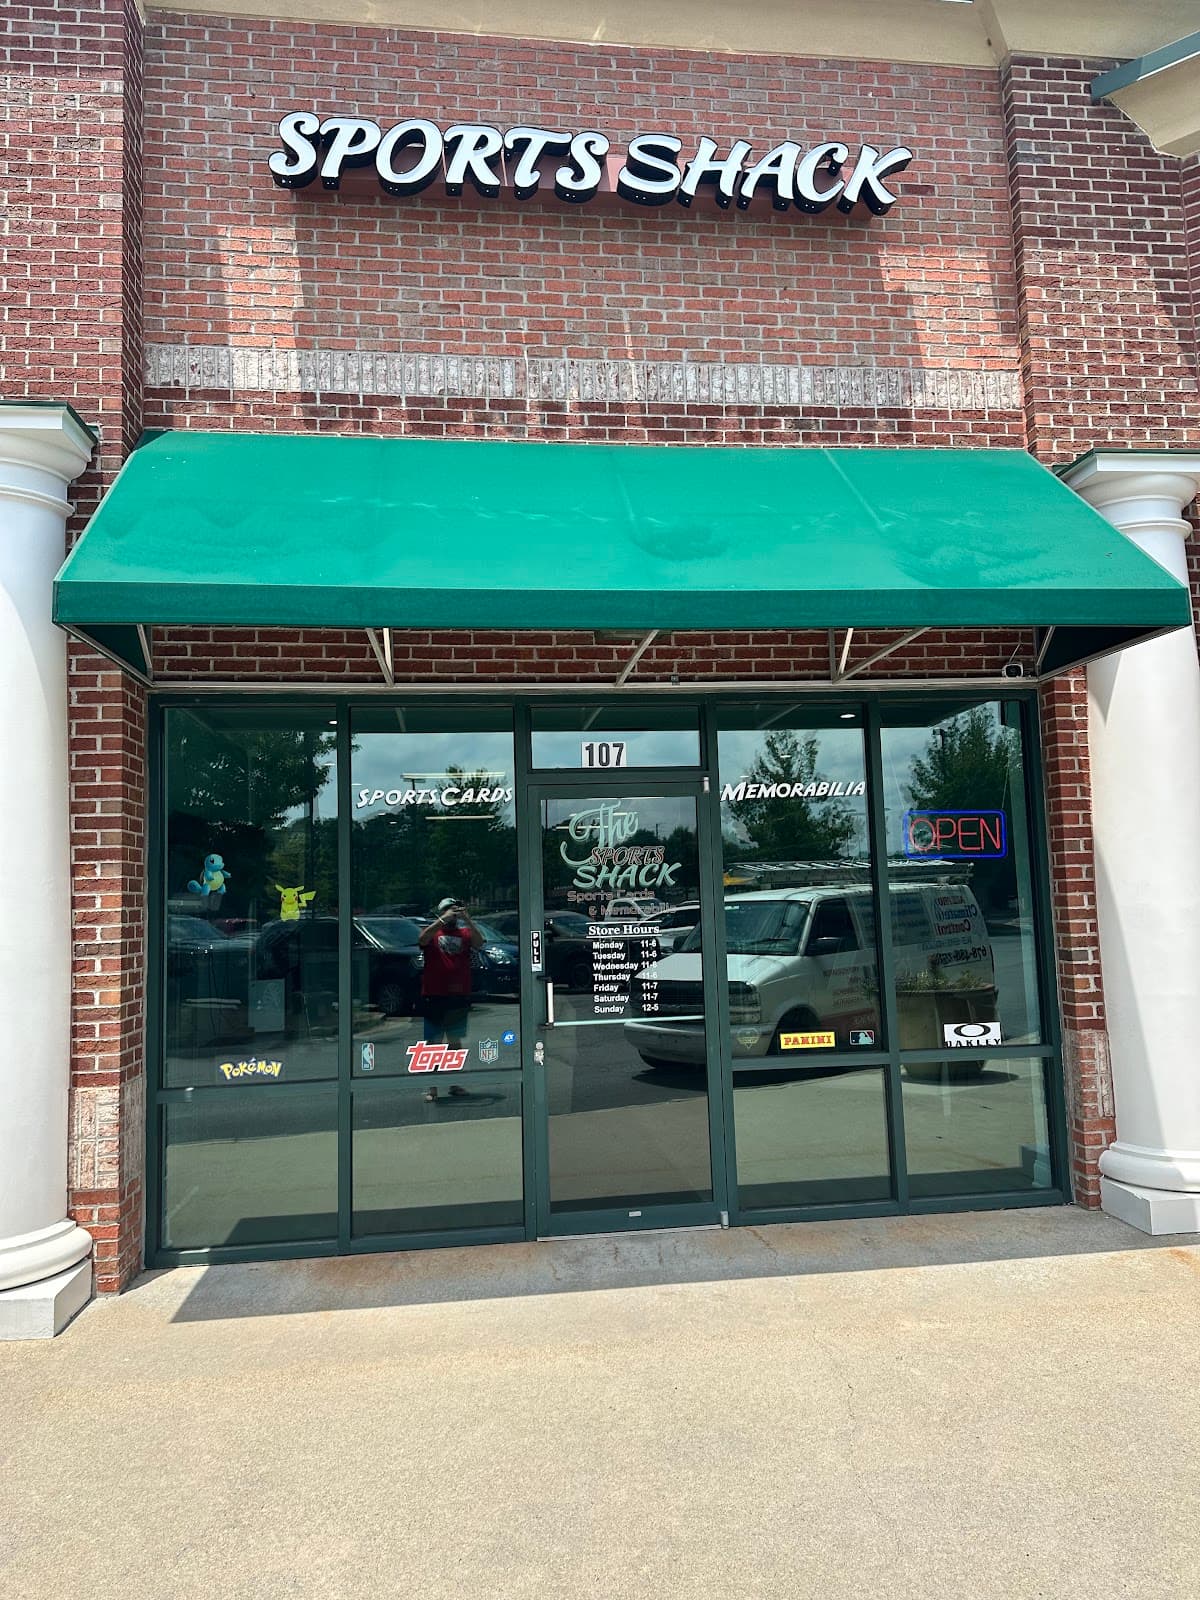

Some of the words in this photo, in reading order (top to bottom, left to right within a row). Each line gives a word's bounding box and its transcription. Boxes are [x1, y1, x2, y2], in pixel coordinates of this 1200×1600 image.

[267, 111, 611, 201] SPORTS
[617, 134, 913, 213] SHACK
[585, 742, 625, 767] 107
[720, 781, 866, 801] MEMORABILIA
[560, 800, 639, 867] The
[909, 817, 1000, 851] OPEN
[588, 846, 665, 866] SPORTS
[572, 862, 682, 889] SHACK
[567, 890, 614, 903] Sports
[616, 888, 655, 900] Cards
[588, 925, 620, 936] Store
[623, 924, 660, 935] Hours
[532, 932, 540, 963] PULL
[592, 941, 624, 951] Monday
[592, 951, 626, 961] Tuesday
[592, 962, 639, 972] Wednesday
[593, 972, 631, 982] Thursday
[593, 983, 619, 993] Friday
[641, 982, 658, 990] 11-7
[593, 994, 630, 1004] Saturday
[642, 992, 659, 1001] 11-7
[594, 1005, 625, 1014] Sunday
[642, 1003, 659, 1012] 12-5
[783, 1034, 832, 1046] PANINI
